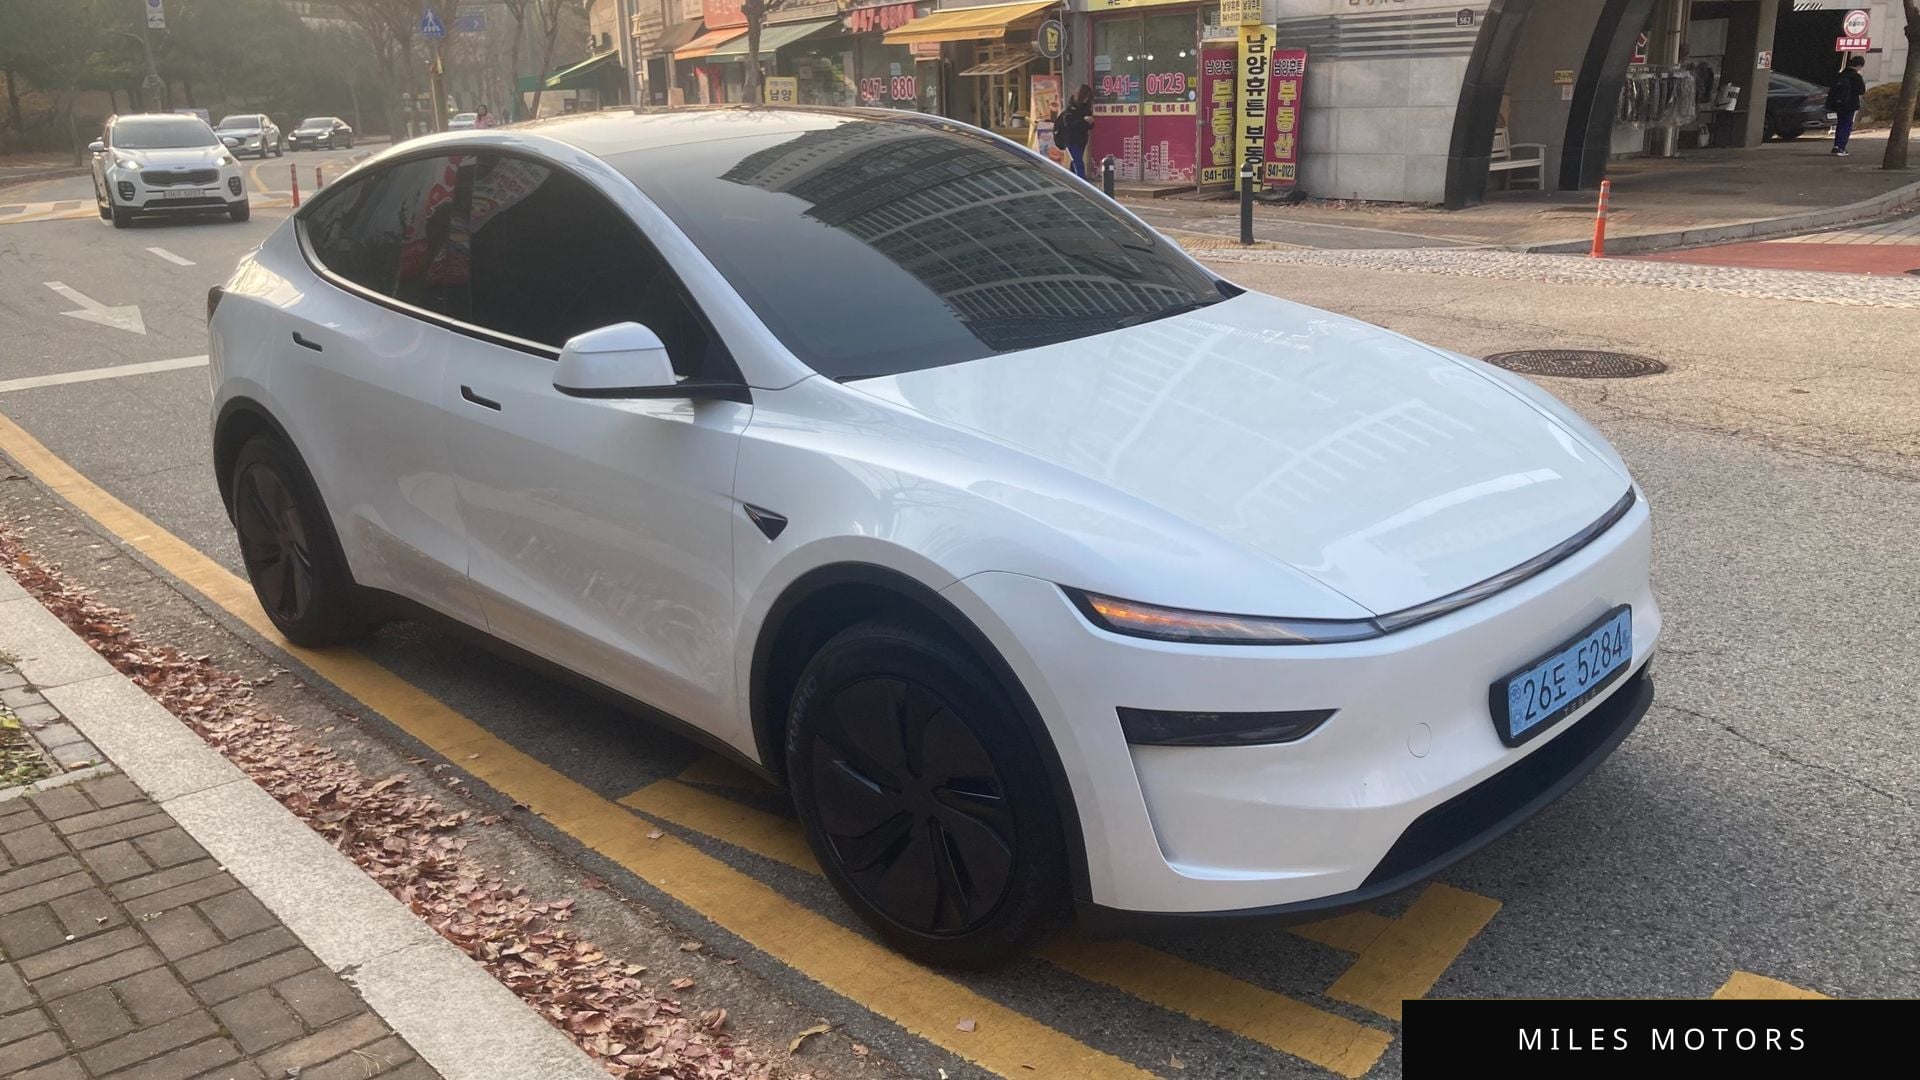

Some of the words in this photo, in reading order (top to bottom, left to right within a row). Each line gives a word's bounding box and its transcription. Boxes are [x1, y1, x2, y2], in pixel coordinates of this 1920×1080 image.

[1206, 60, 1235, 76] 남양휴
[1245, 34, 1267, 118] 남양휴튼
[1273, 58, 1305, 76] 남양휴튼
[1146, 72, 1186, 95] 0123
[769, 89, 793, 102] 남양
[1210, 79, 1234, 166] 부동산
[1274, 80, 1298, 159] 부동산
[1204, 168, 1235, 181] 941-012
[1267, 164, 1294, 177] 941-0123
[1523, 662, 1567, 721] 26도
[1577, 622, 1623, 686] 5284
